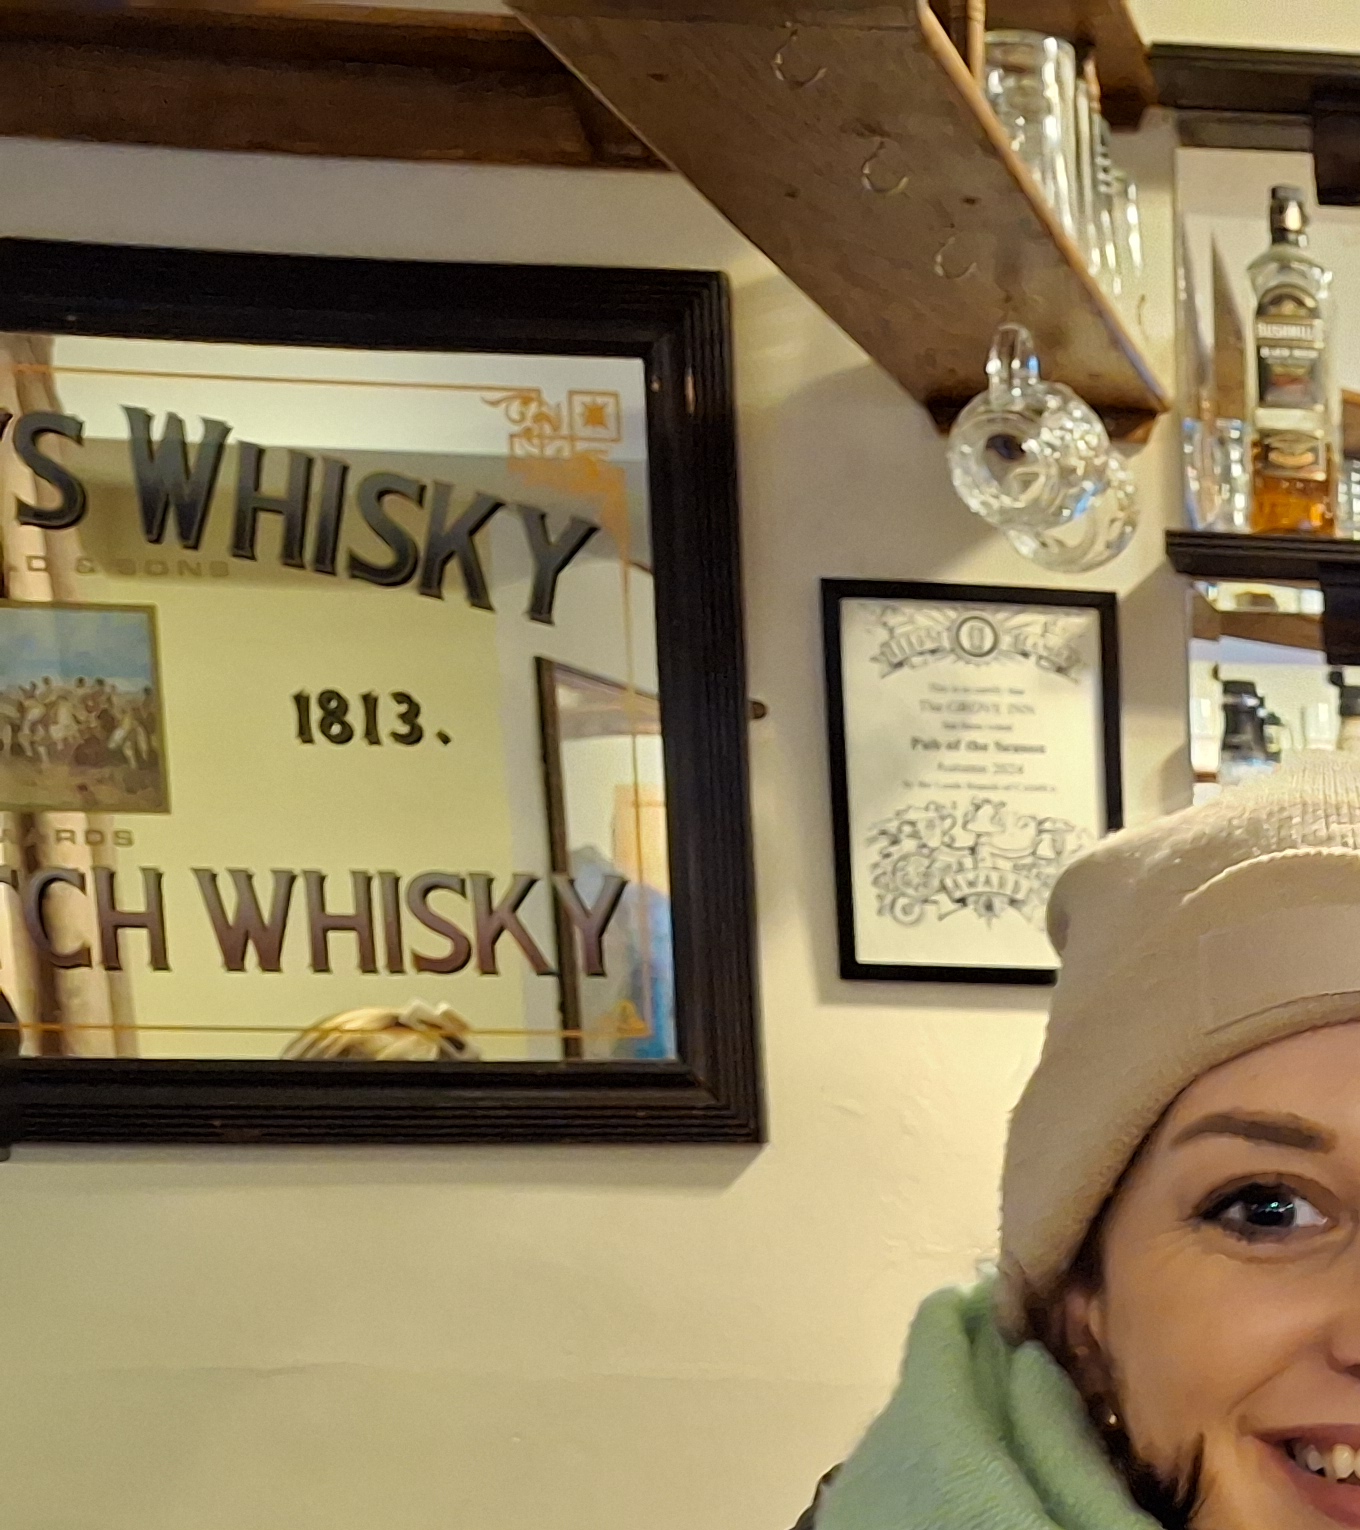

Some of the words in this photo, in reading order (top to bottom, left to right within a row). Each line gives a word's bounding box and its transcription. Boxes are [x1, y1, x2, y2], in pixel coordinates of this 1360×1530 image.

[0, 408, 86, 529] S
[119, 404, 599, 626] WHISKY
[114, 557, 230, 578] SONS
[293, 689, 451, 746] 1813.
[190, 867, 629, 977] WHISKY
